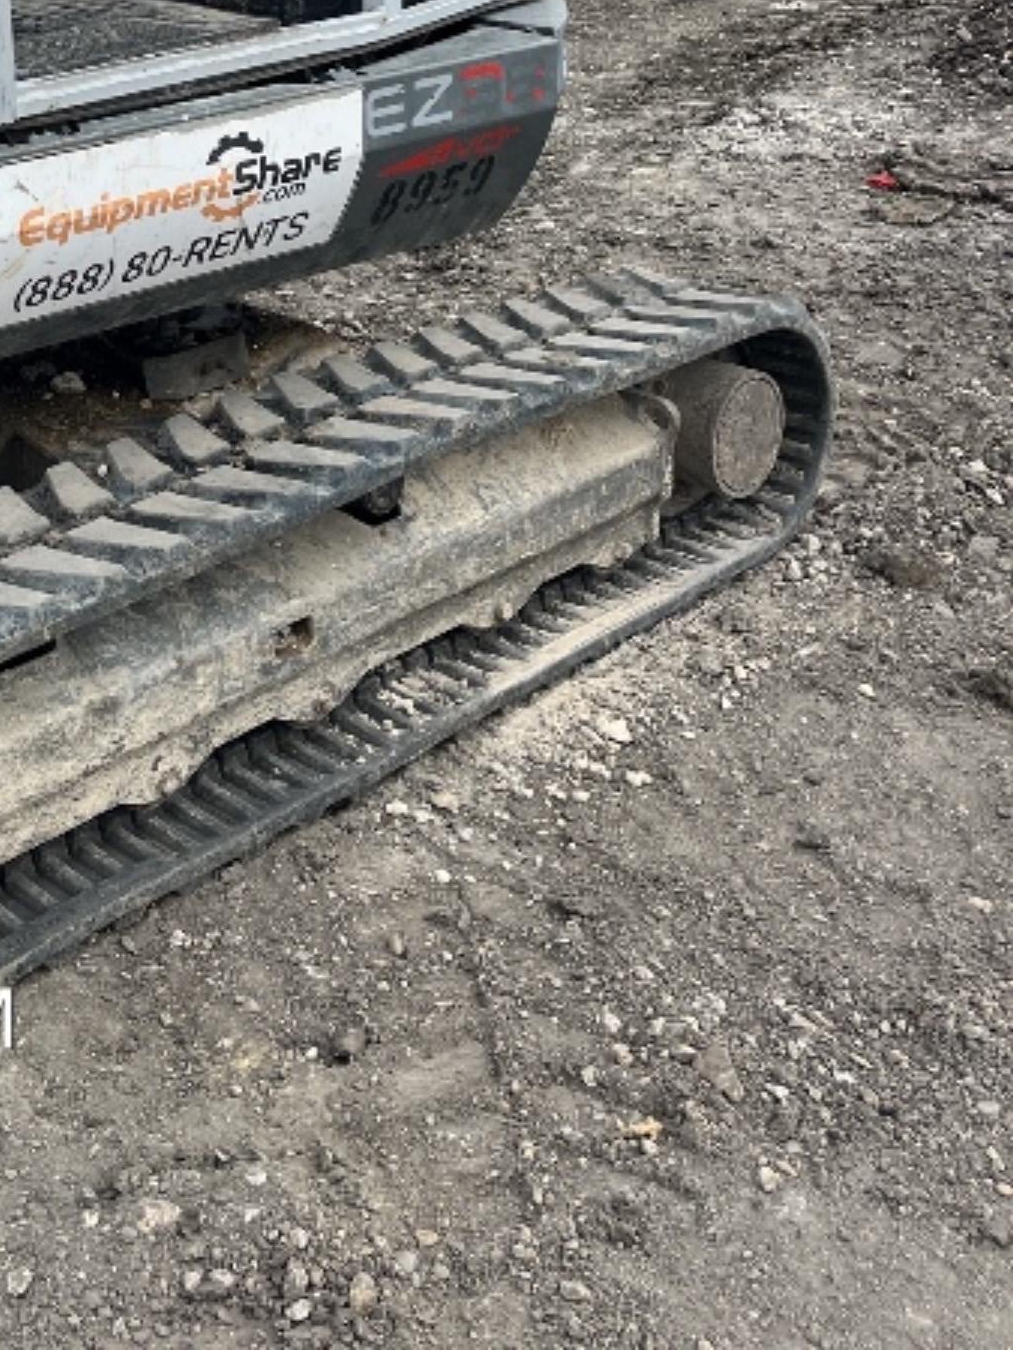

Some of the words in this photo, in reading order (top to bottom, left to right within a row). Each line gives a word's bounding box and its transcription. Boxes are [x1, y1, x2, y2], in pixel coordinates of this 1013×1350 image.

[18, 148, 342, 246] EquipmentShare
[371, 155, 495, 226] 8959
[13, 258, 115, 313] (888)
[122, 212, 310, 284] 80-RENTS
